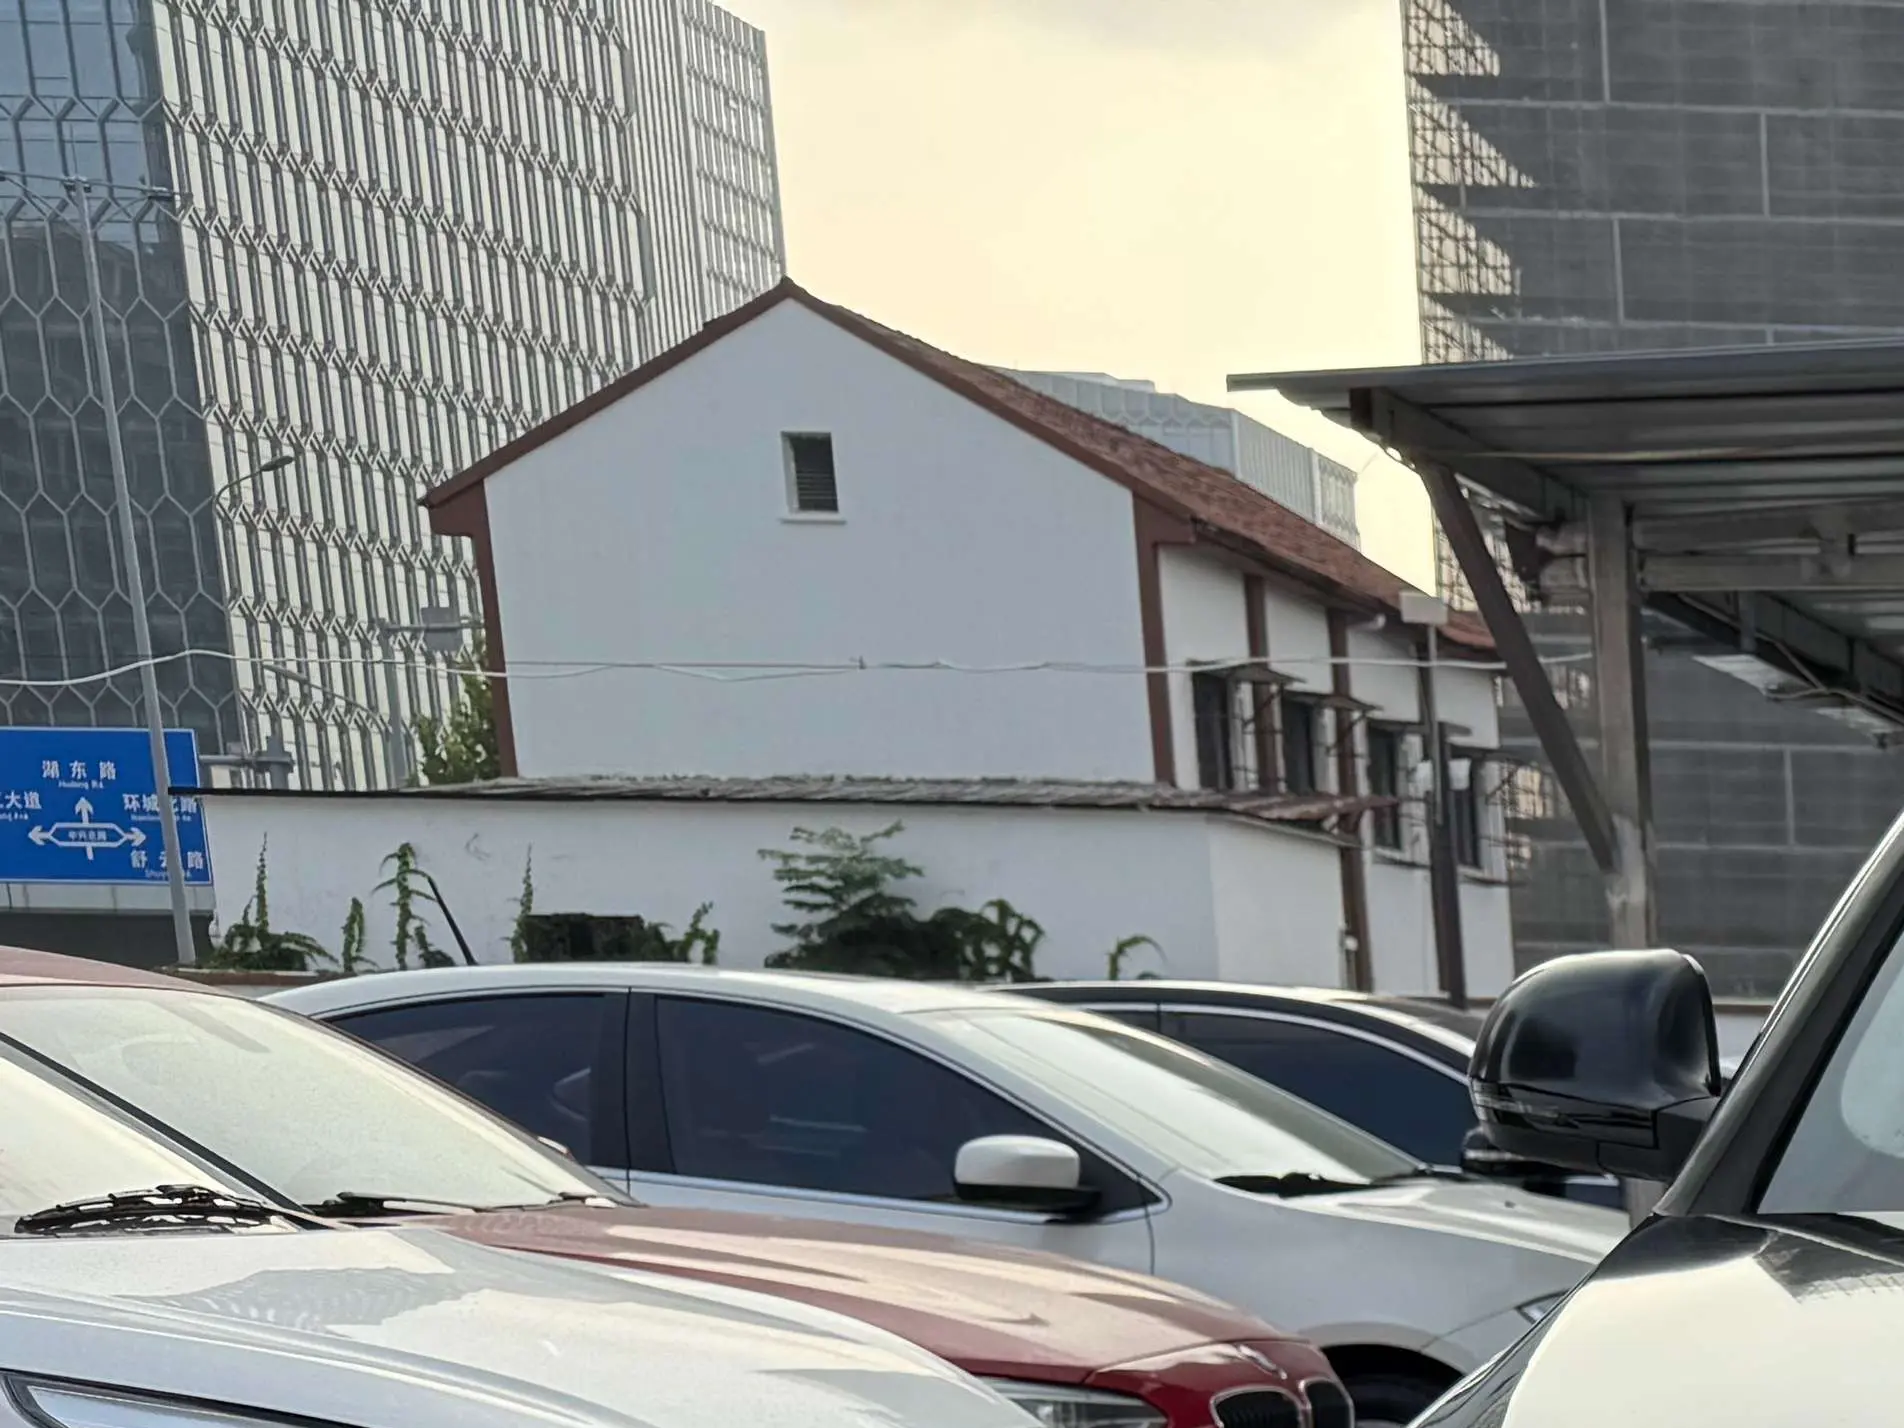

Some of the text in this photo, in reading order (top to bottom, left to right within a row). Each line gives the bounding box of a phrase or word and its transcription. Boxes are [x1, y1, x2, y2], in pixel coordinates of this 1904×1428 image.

[42, 759, 116, 780] 湖东路
[0, 790, 42, 809] 大道
